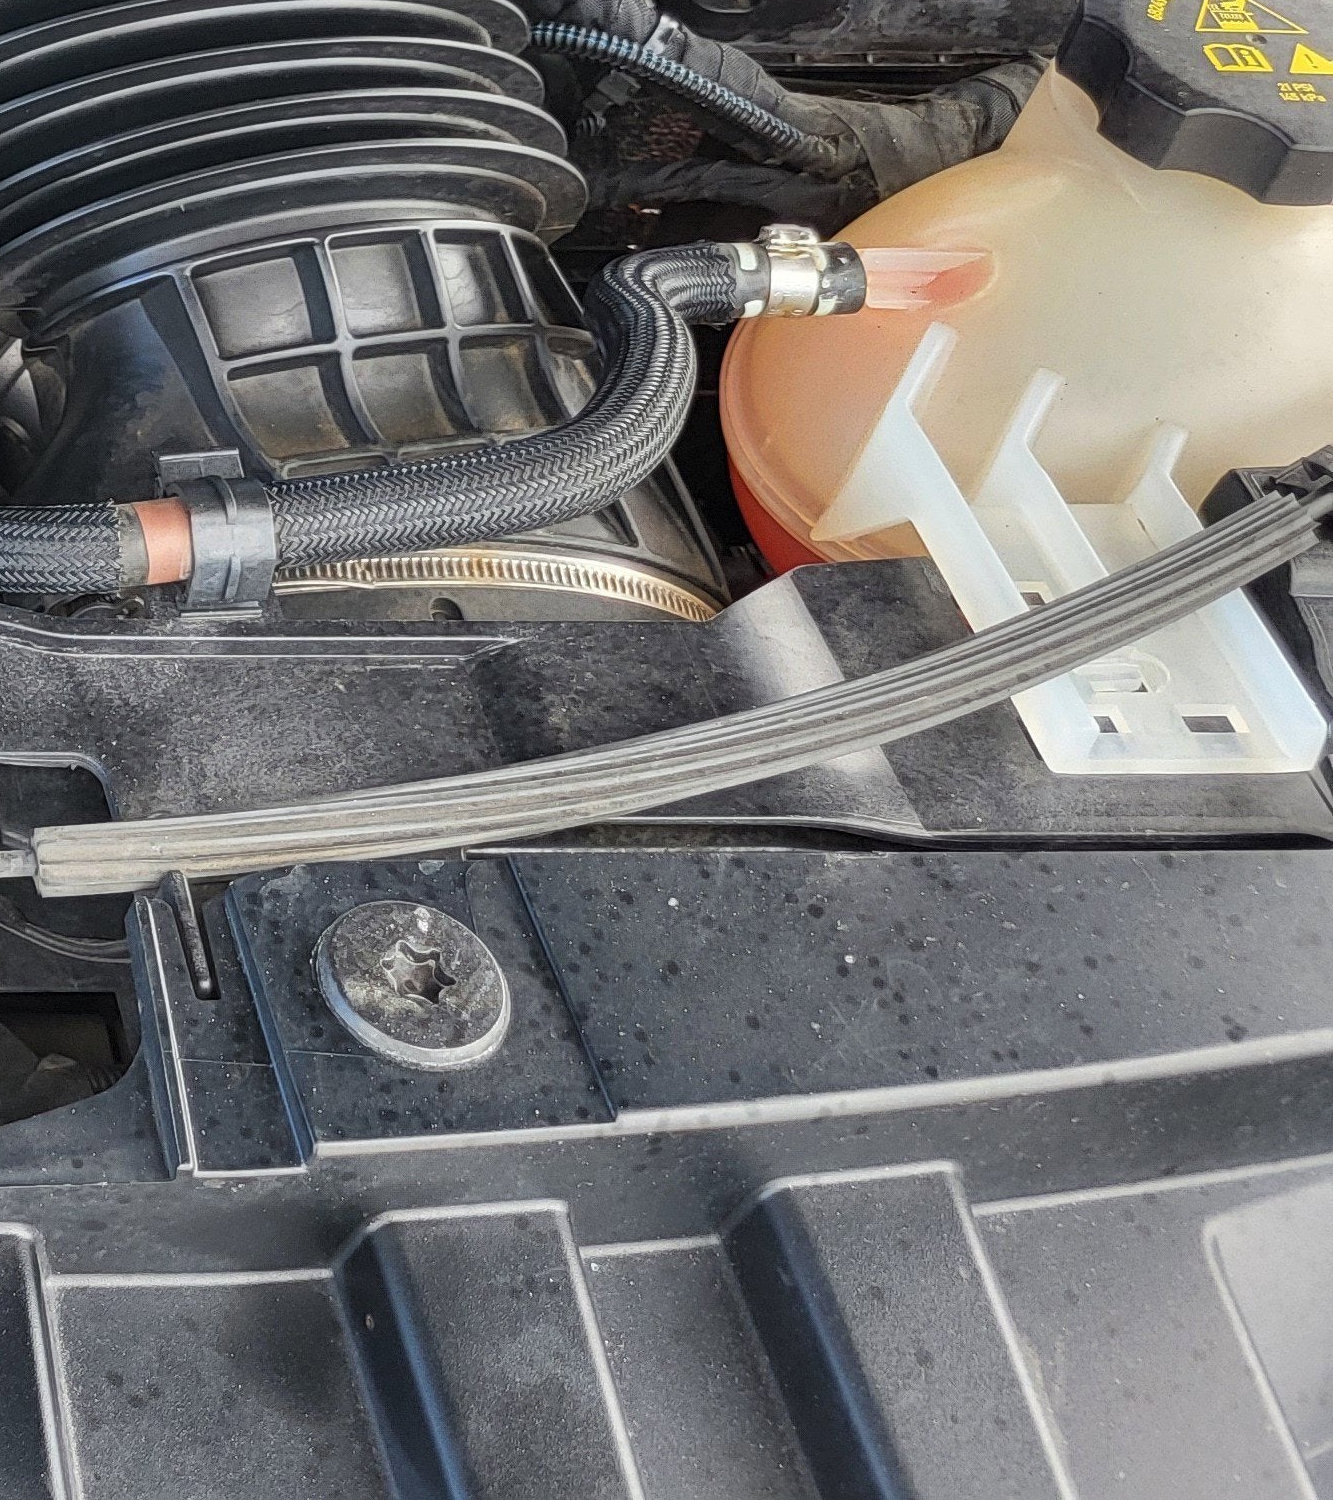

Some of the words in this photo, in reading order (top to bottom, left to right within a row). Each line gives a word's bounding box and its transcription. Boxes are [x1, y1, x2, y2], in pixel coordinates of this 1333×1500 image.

[1276, 82, 1292, 92] 21
[1291, 82, 1316, 92] PSI
[1279, 91, 1300, 102] 145
[1301, 91, 1328, 104] kPa
